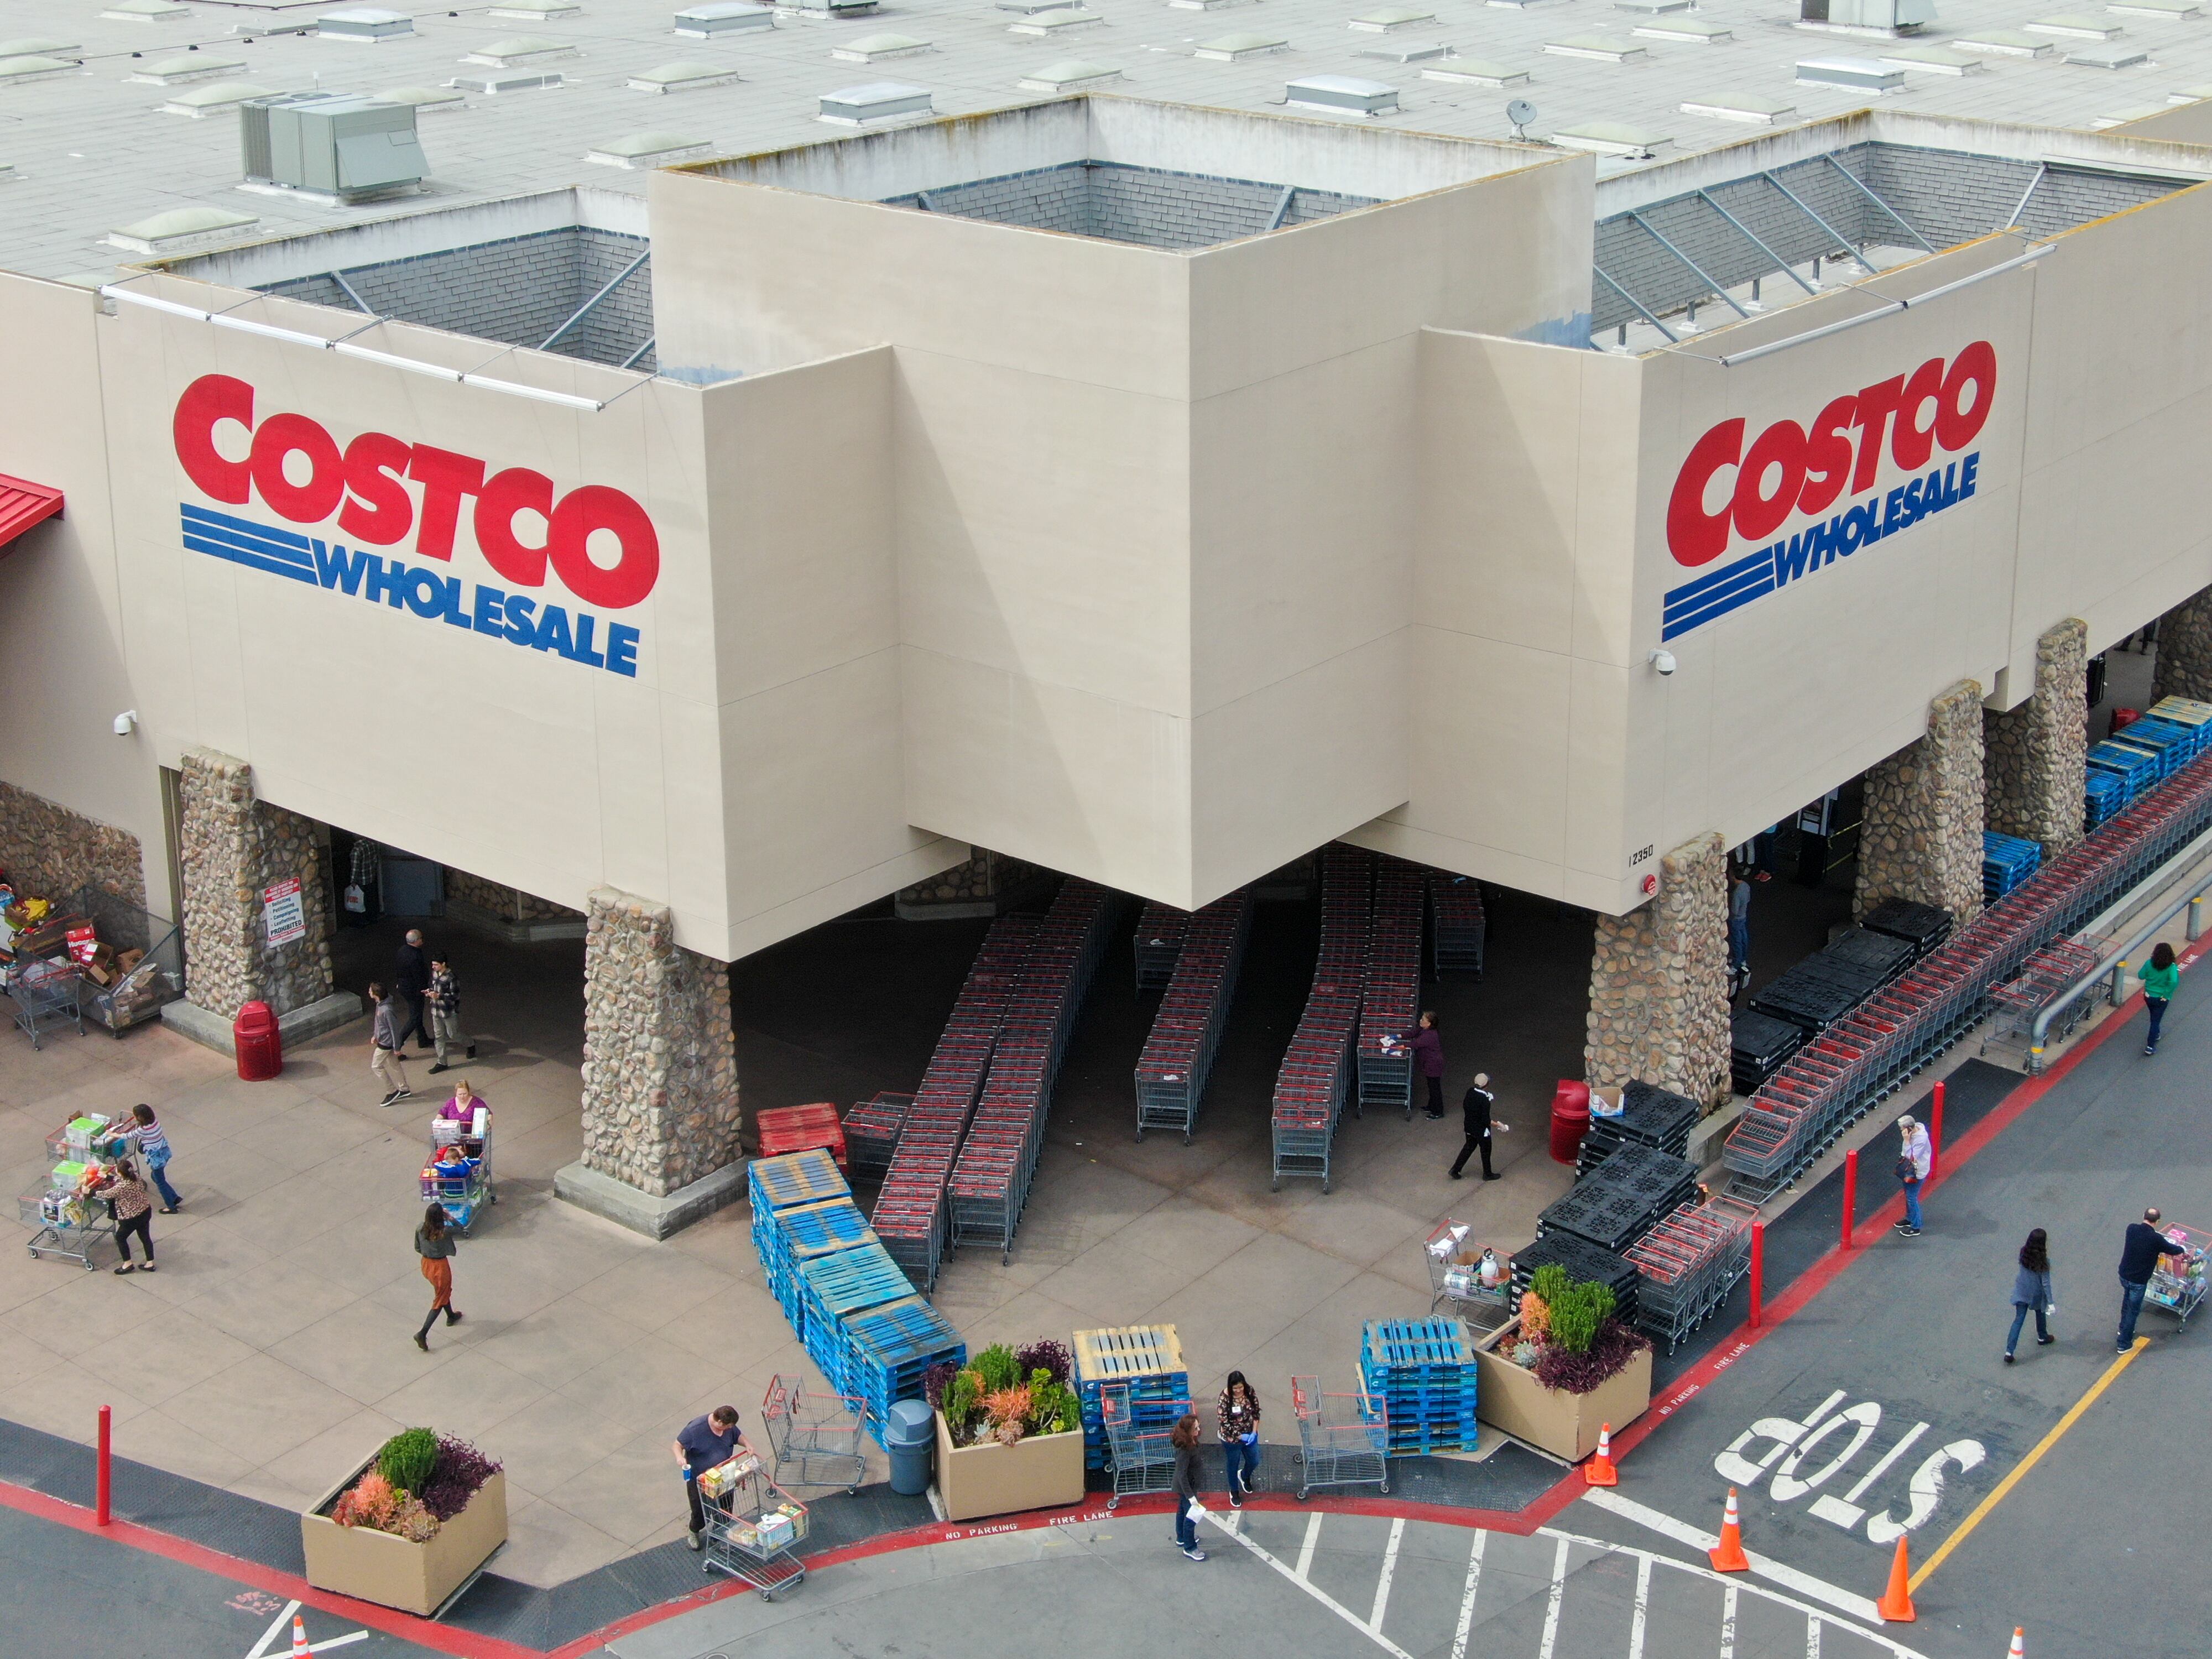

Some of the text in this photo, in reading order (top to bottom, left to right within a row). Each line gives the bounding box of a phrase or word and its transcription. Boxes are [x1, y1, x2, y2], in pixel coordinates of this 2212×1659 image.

[173, 374, 659, 609] COSTCO
[1666, 341, 1996, 567] COSTCO
[1773, 451, 1980, 588] WHOLESALE
[310, 538, 640, 677] WHOLESALE
[1629, 844, 1653, 867] 12350
[270, 920, 302, 936] PROHIBITED
[1658, 1342, 1750, 1415] NO PARKING FIRE LANE
[945, 1511, 1113, 1540] NO PARKING FIRE LANE
[1714, 1389, 1985, 1543] STOP
